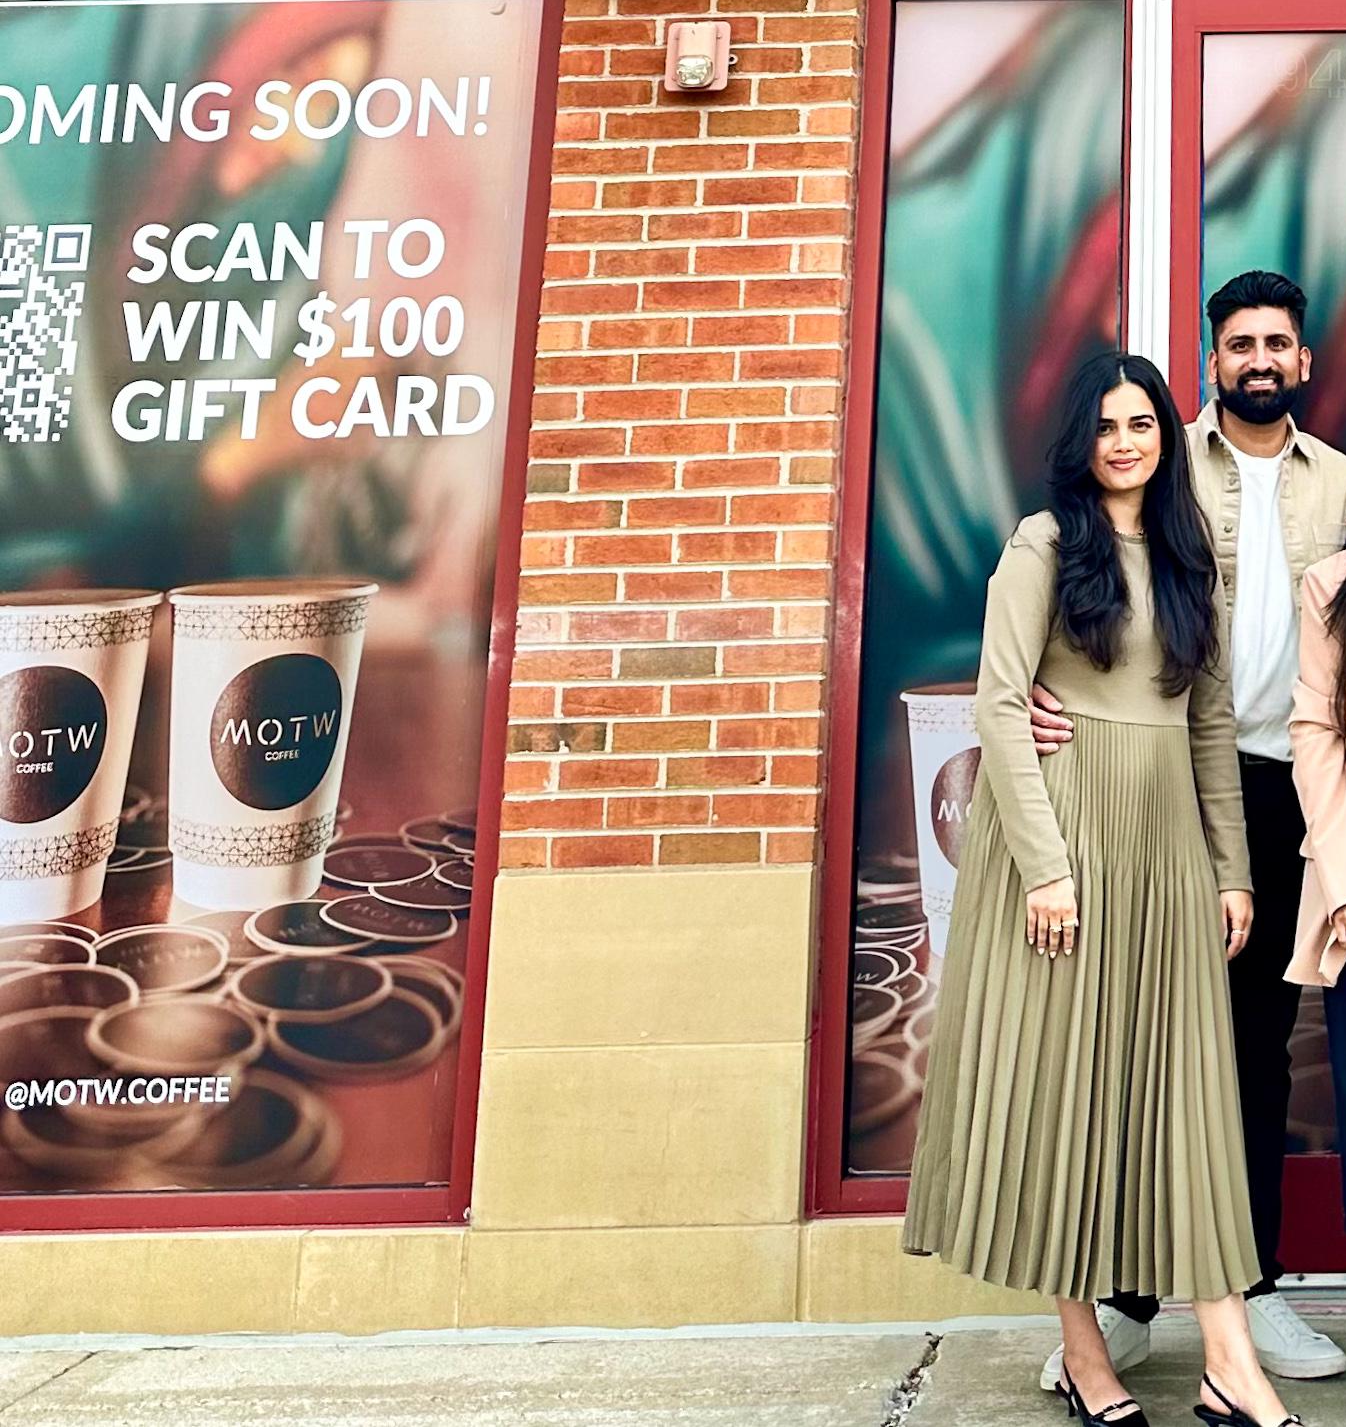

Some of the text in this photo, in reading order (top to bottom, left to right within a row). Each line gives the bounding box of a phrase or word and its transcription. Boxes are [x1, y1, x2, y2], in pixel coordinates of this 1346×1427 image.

[249, 76, 492, 141] SOON!
[127, 218, 446, 284] SCAN TO
[122, 291, 466, 367] WIN $100
[111, 374, 496, 443] GIFT CARD
[0, 721, 98, 758] OTW
[220, 709, 337, 746] MOTW
[16, 761, 54, 774] COFFEE
[5, 1076, 233, 1111] @MOTW.COFFEE
